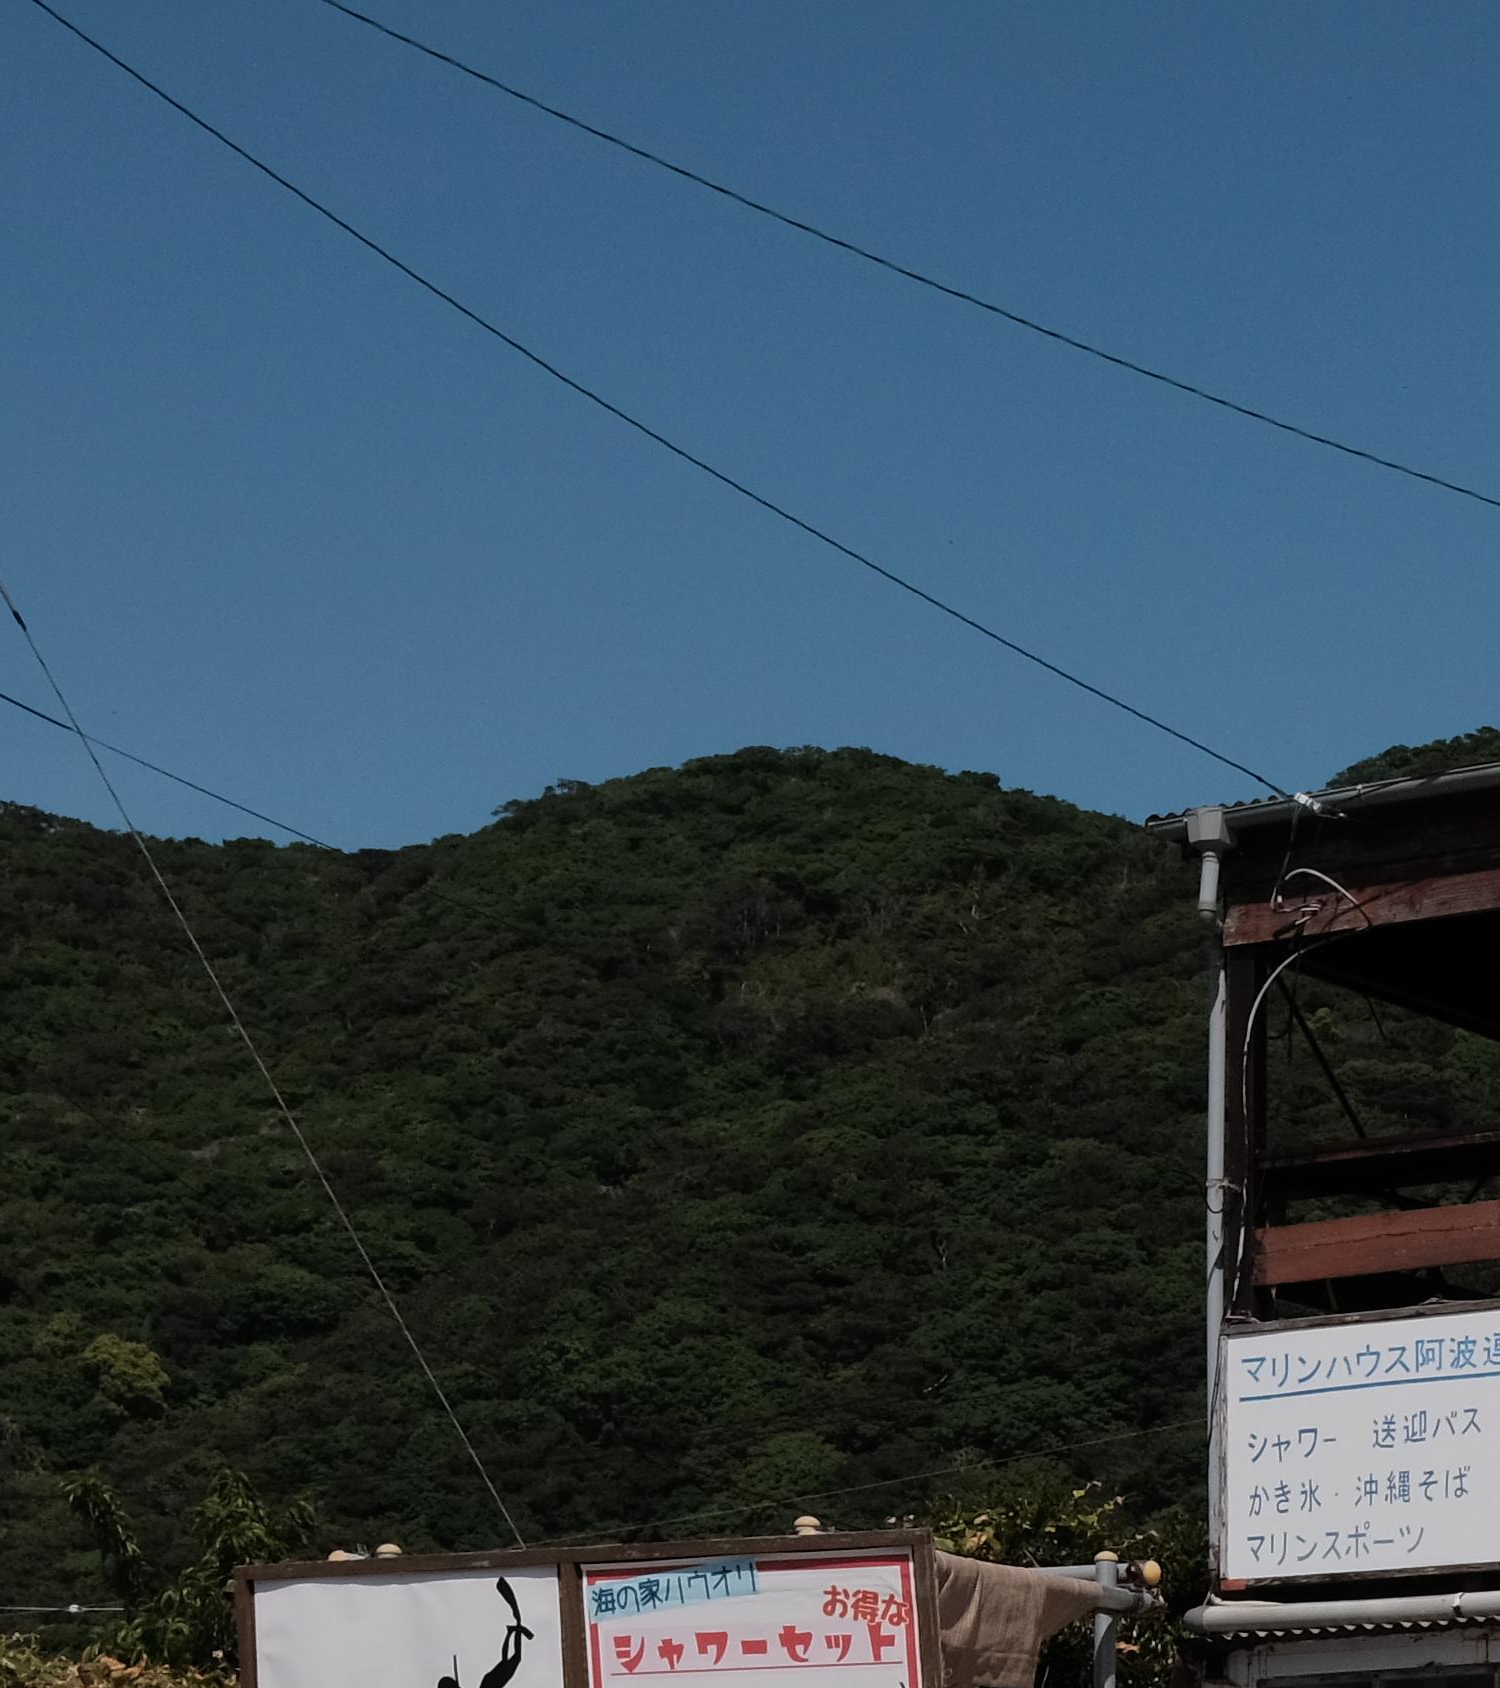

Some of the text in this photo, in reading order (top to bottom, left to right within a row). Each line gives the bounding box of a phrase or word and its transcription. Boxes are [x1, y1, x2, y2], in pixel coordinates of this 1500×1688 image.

[1246, 1406, 1483, 1465] シャワー 送迎バス
[1246, 1524, 1425, 1564] マリンスポーツ
[822, 1584, 909, 1627] お得な
[612, 1621, 897, 1674] シャワーセット
